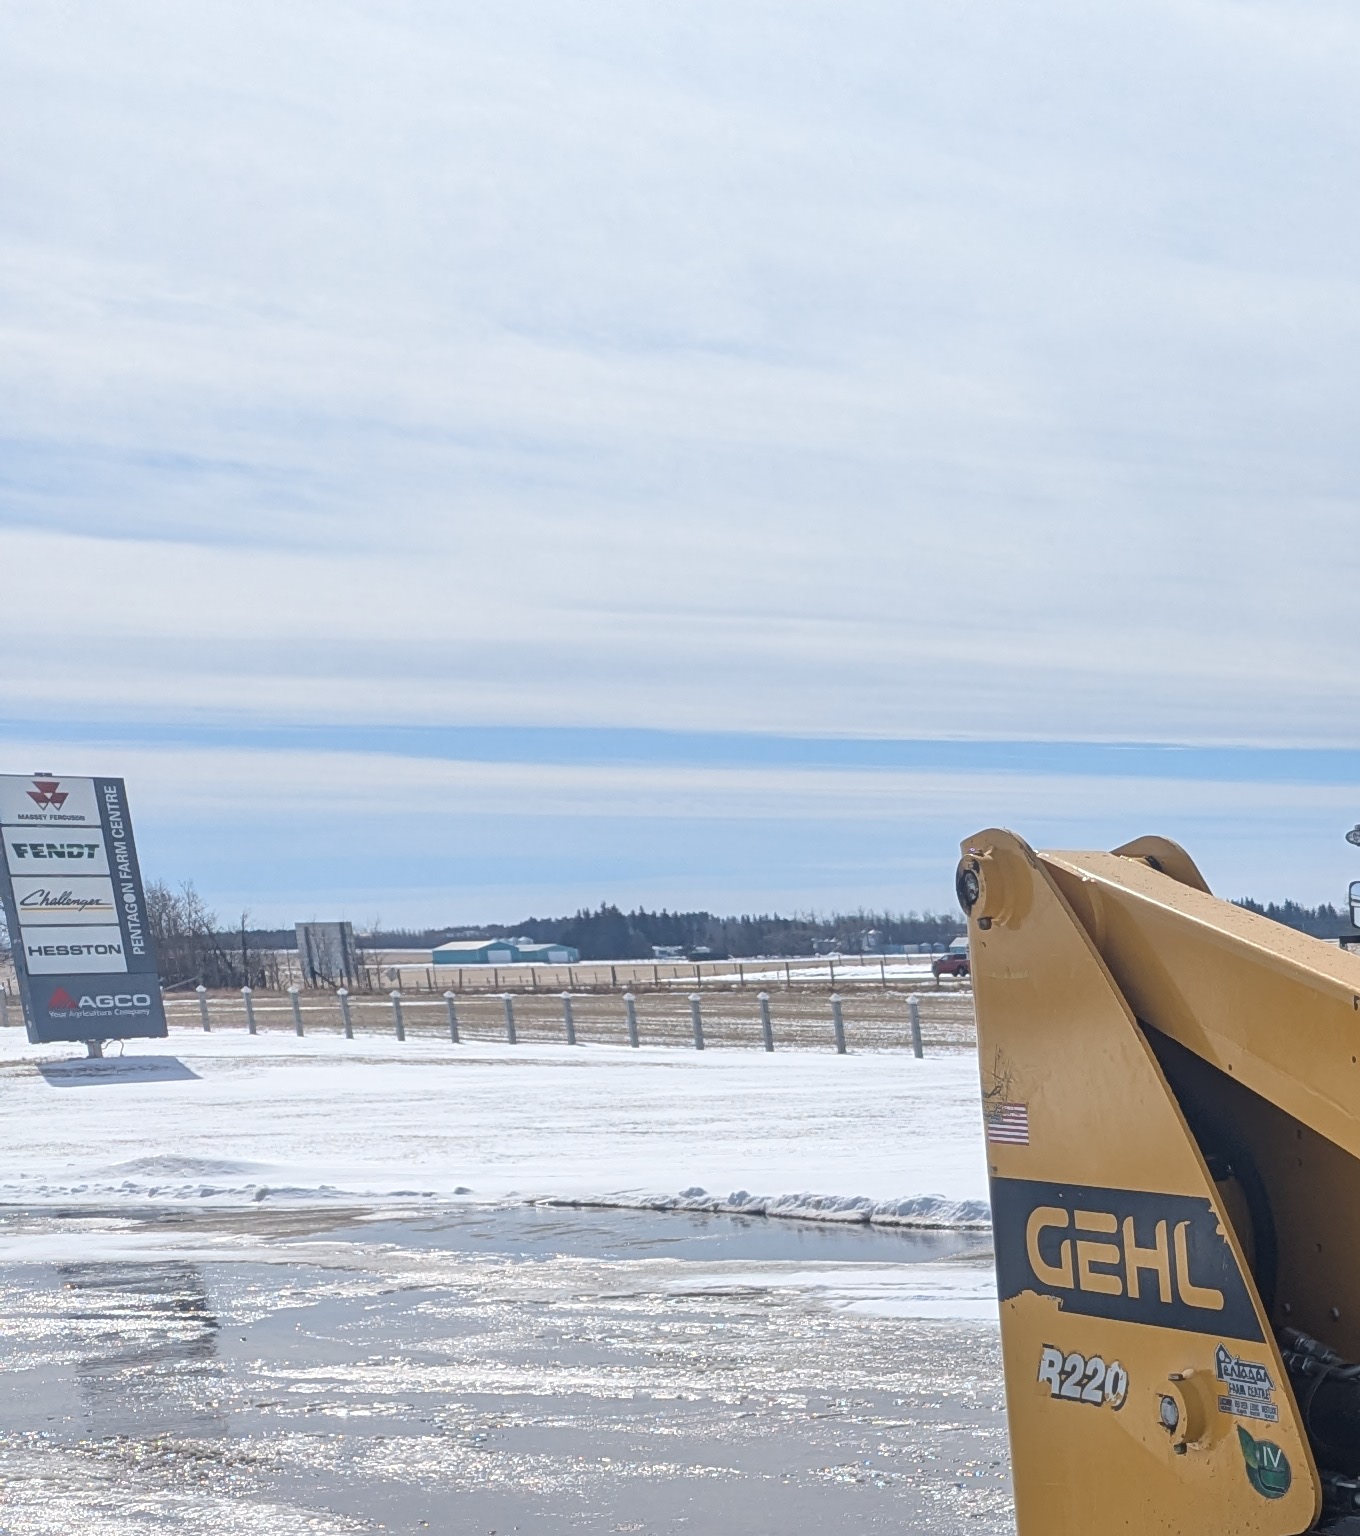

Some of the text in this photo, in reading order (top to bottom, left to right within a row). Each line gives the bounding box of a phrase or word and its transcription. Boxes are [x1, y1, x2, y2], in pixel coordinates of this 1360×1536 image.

[12, 843, 100, 859] FENDT
[104, 785, 145, 955] PENTAGON FARM CENTRE
[20, 889, 108, 911] Challenger
[28, 944, 122, 956] HESSTON
[79, 994, 151, 1008] AGCO
[1026, 1206, 1225, 1311] GEHL
[1037, 1344, 1129, 1410] R220
[1262, 1446, 1282, 1468] IV
